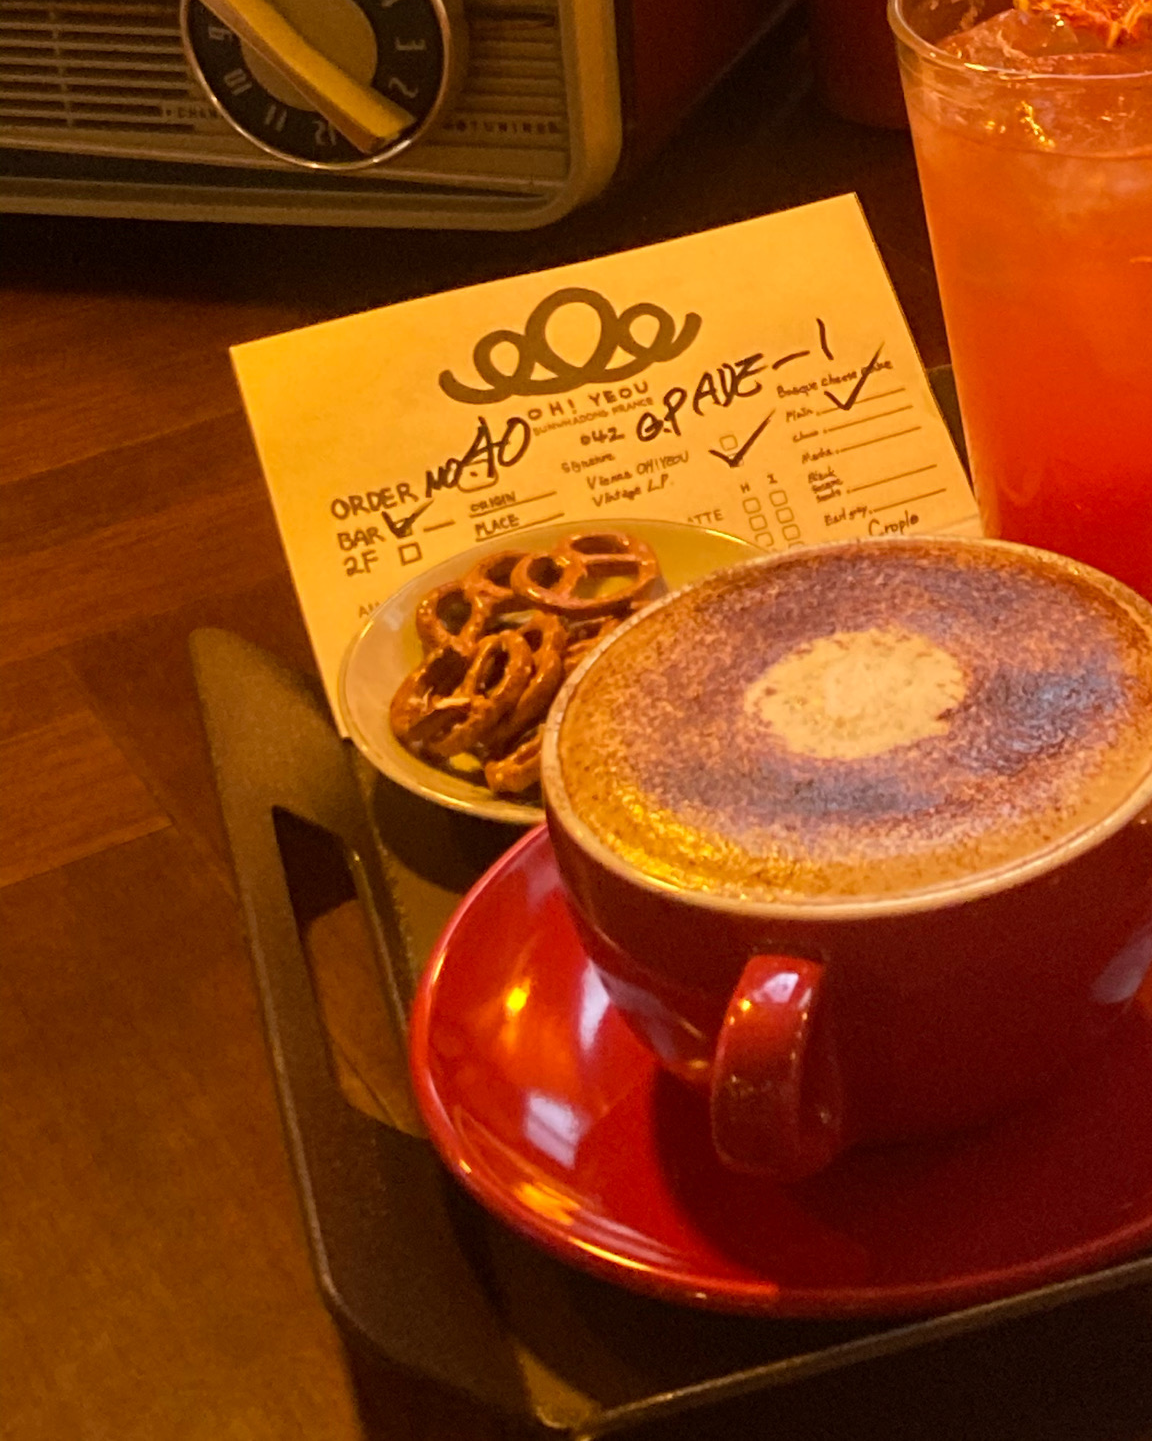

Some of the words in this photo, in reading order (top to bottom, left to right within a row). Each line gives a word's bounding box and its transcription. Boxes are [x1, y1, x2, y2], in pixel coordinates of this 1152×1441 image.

[396, 39, 427, 51] 3
[388, 77, 418, 98] 2
[527, 398, 577, 420] OH!
[588, 380, 649, 407] YEOU
[331, 482, 419, 520] ORDER
[470, 491, 517, 512] ORIGIN
[475, 513, 520, 536] PLACE
[337, 526, 387, 551] BAR
[343, 549, 379, 577] 2F
